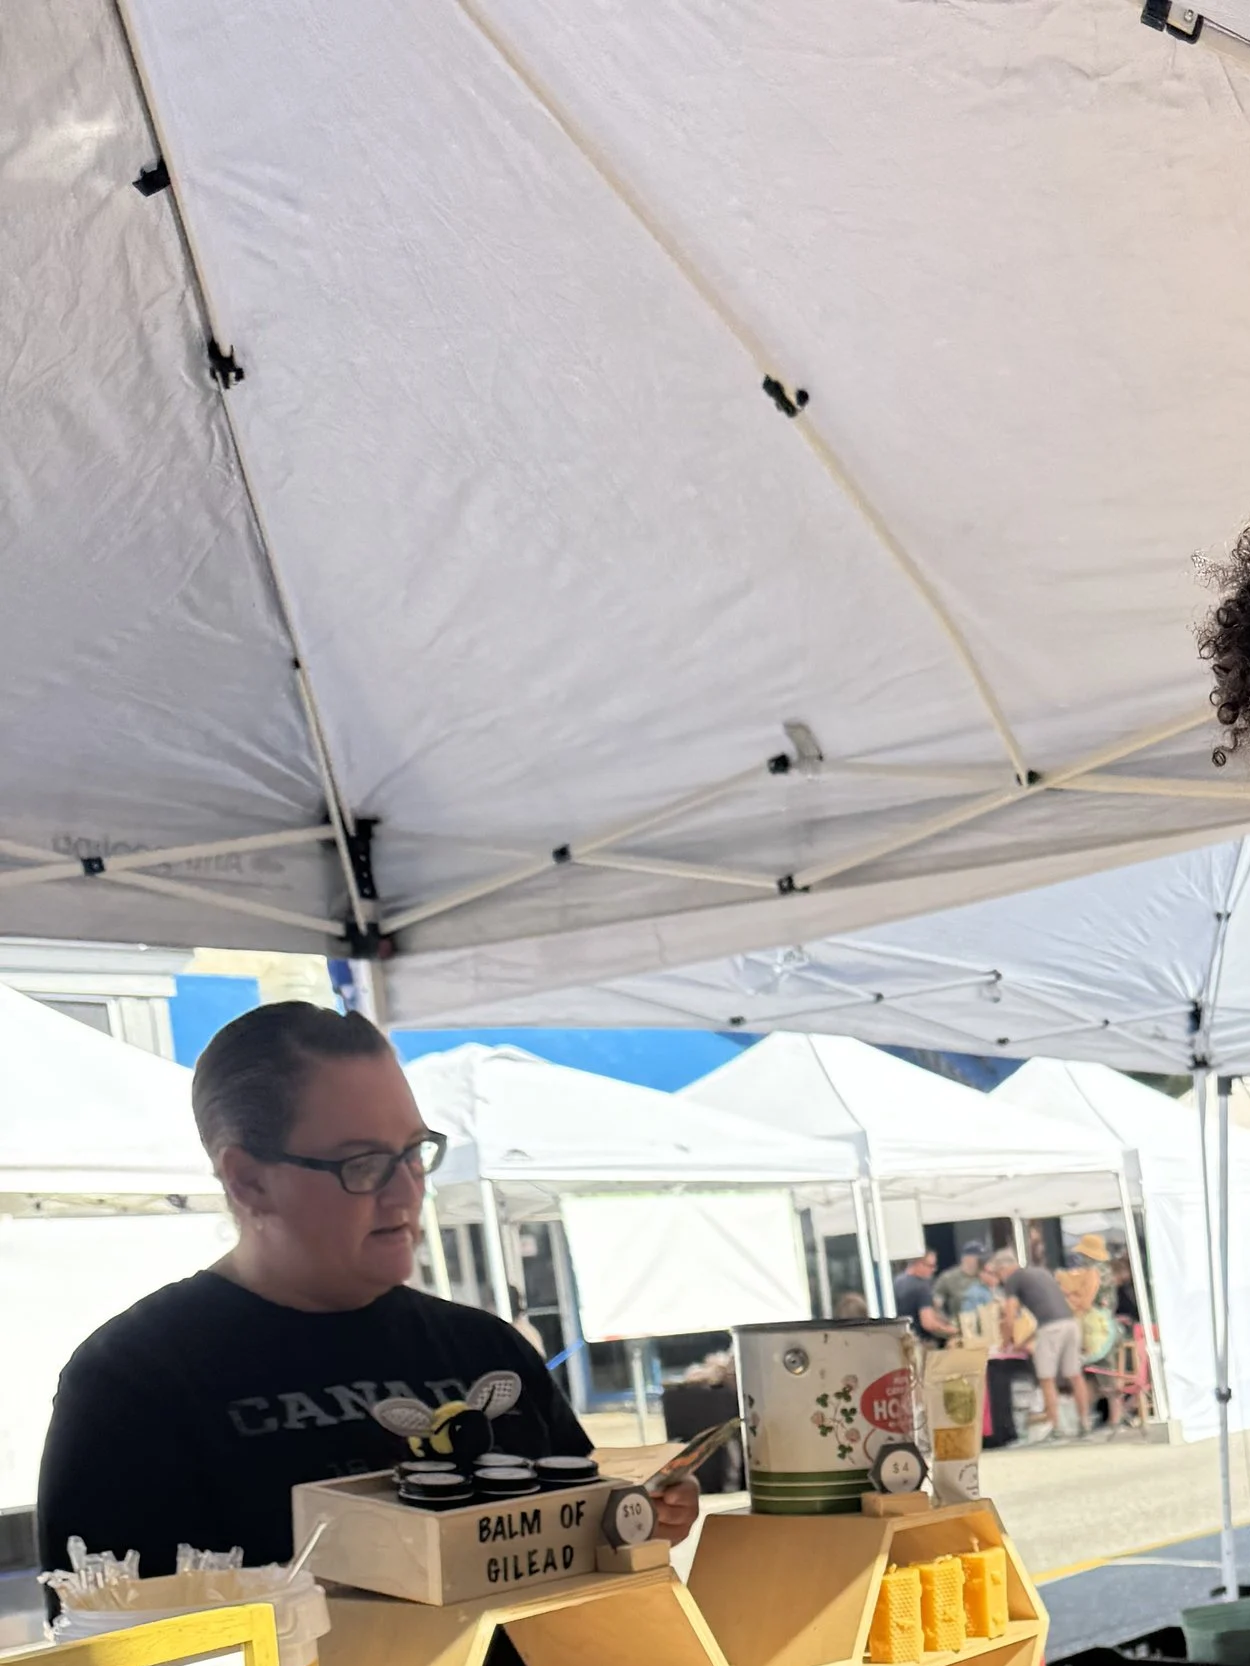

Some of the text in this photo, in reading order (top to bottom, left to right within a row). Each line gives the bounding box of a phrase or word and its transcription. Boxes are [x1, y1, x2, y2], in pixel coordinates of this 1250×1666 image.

[478, 1500, 586, 1544] BALM OF
[622, 1504, 643, 1518] $10
[486, 1544, 575, 1584] GILEAD
